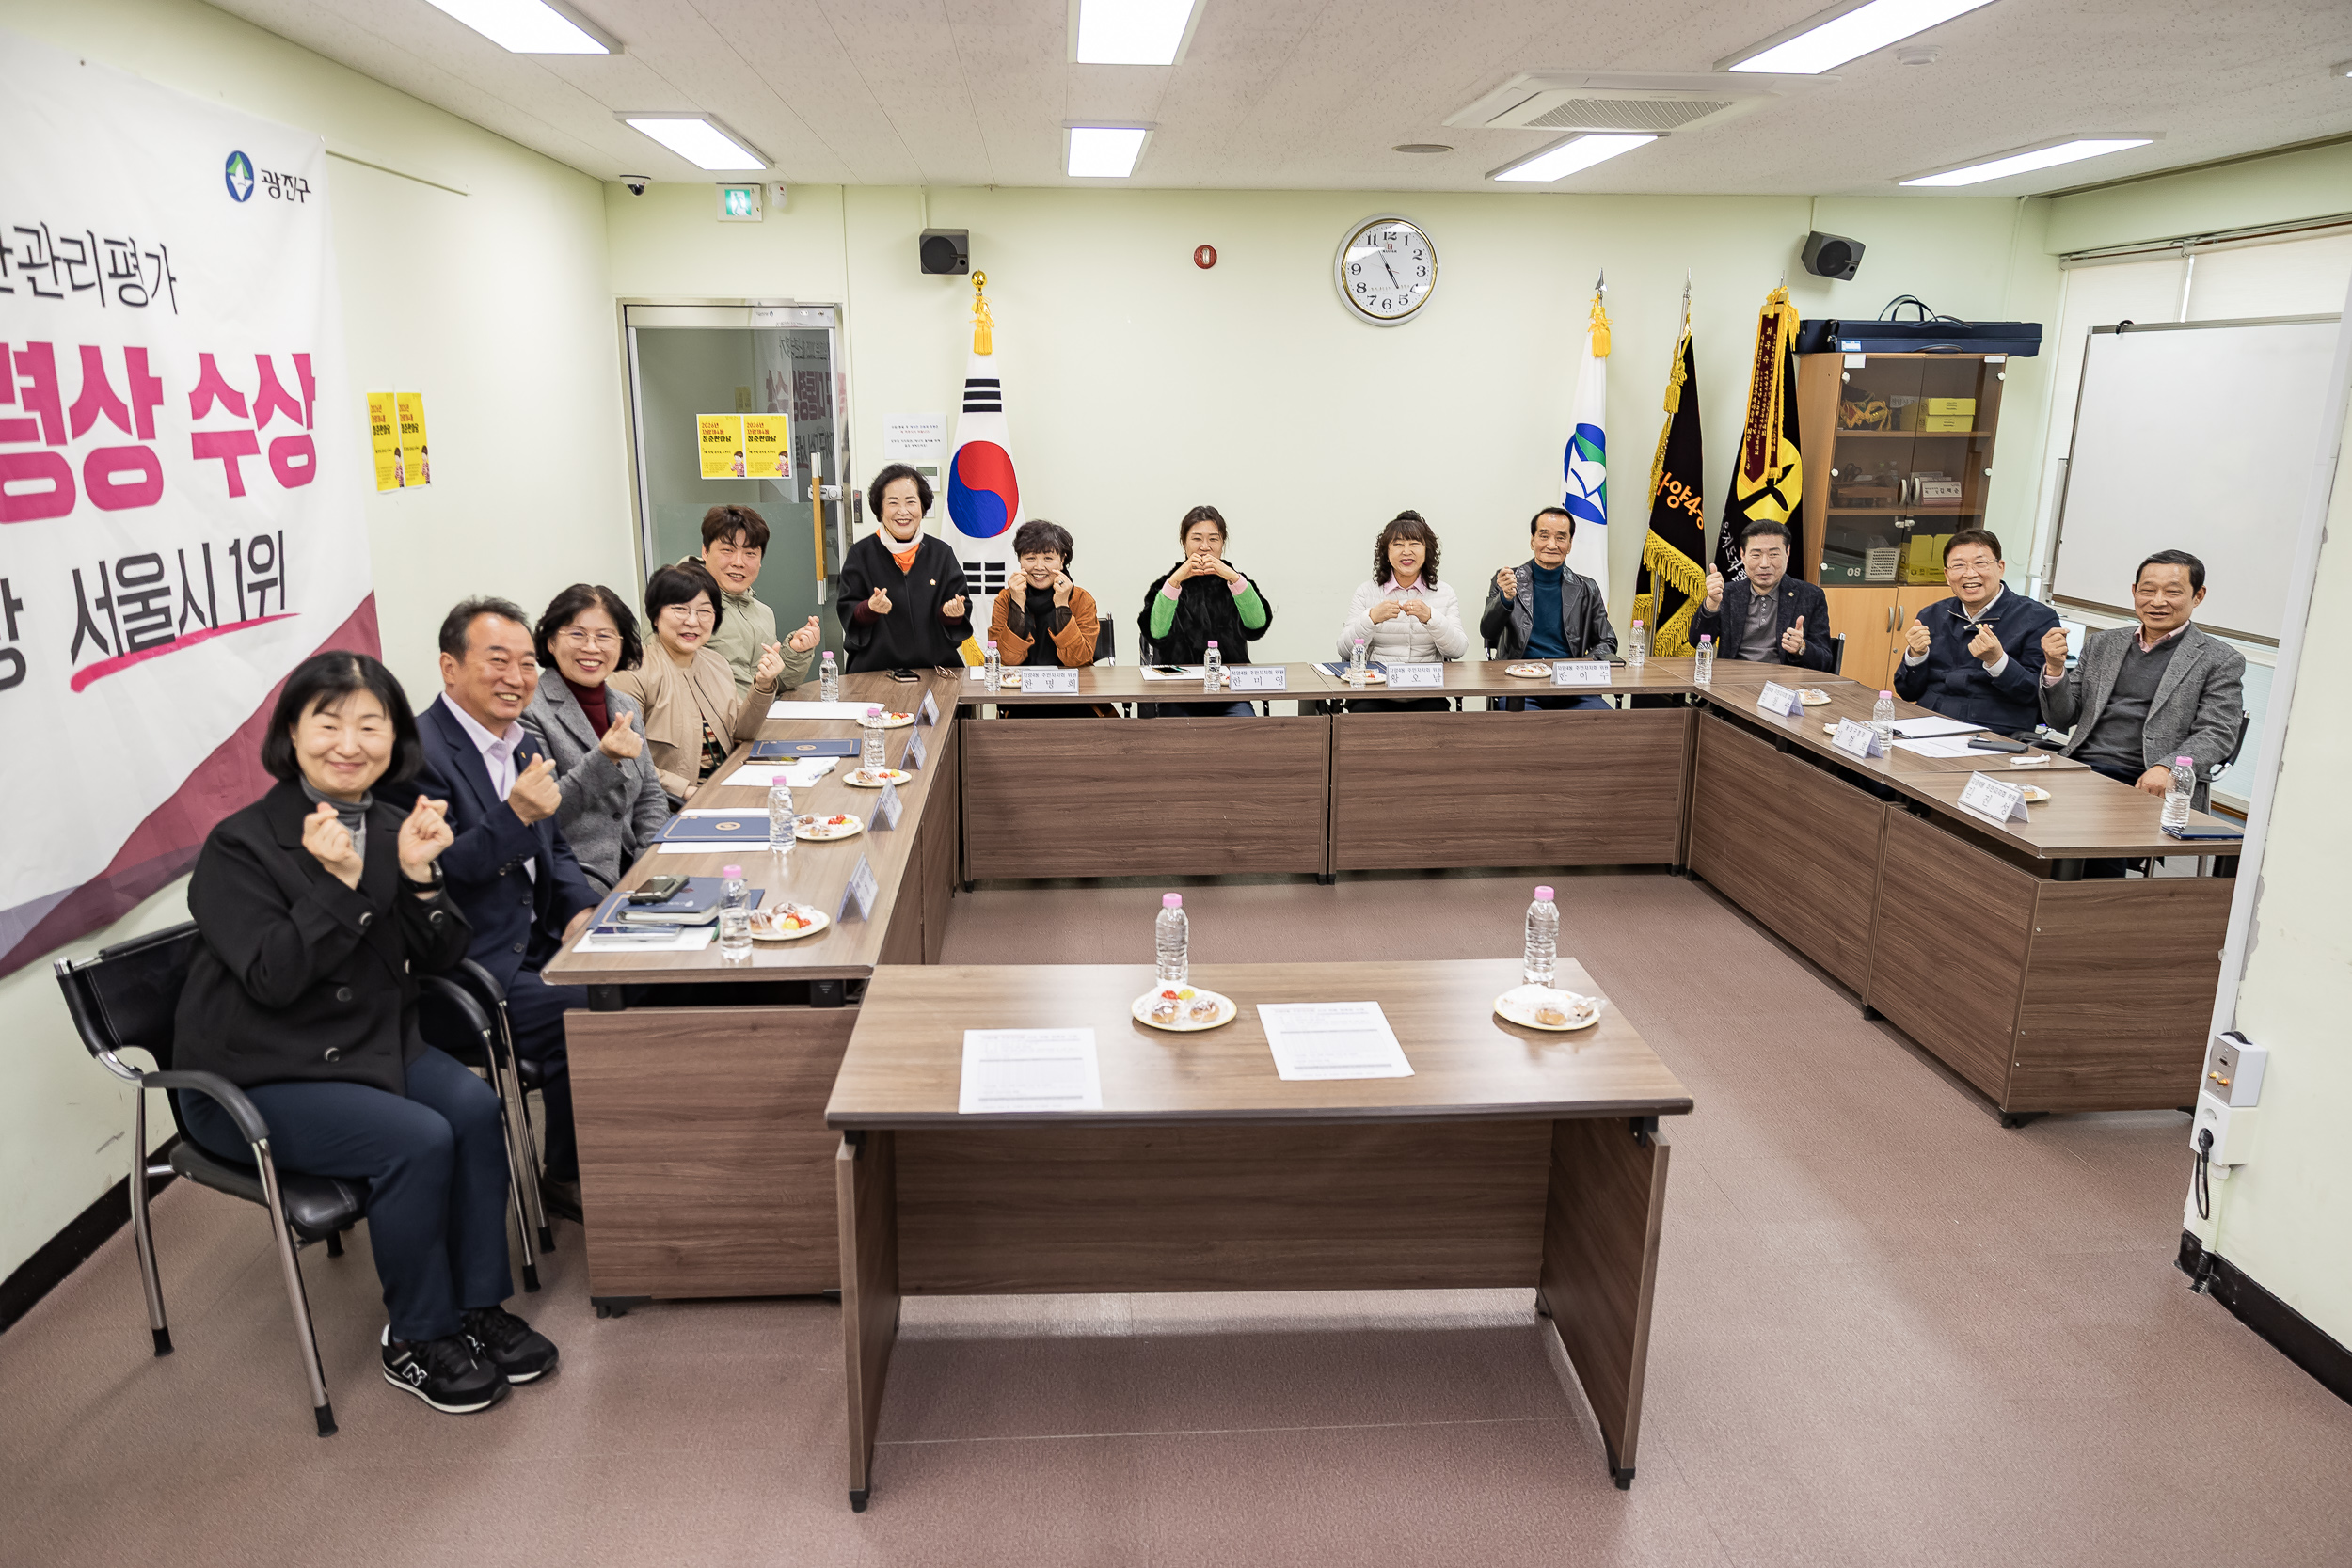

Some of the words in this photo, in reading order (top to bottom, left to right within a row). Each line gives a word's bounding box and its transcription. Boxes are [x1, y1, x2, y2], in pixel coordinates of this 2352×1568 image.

[261, 168, 311, 203] 광진구
[1412, 248, 1423, 261] 2
[1351, 263, 1361, 275] 9
[1416, 265, 1426, 277] 3
[1356, 282, 1367, 293] 8
[1367, 294, 1377, 306] 7
[1382, 298, 1392, 309] 6
[1398, 293, 1408, 306] 5
[188, 352, 316, 498] 수상
[71, 542, 219, 666] 서울시
[229, 530, 285, 622] 1위
